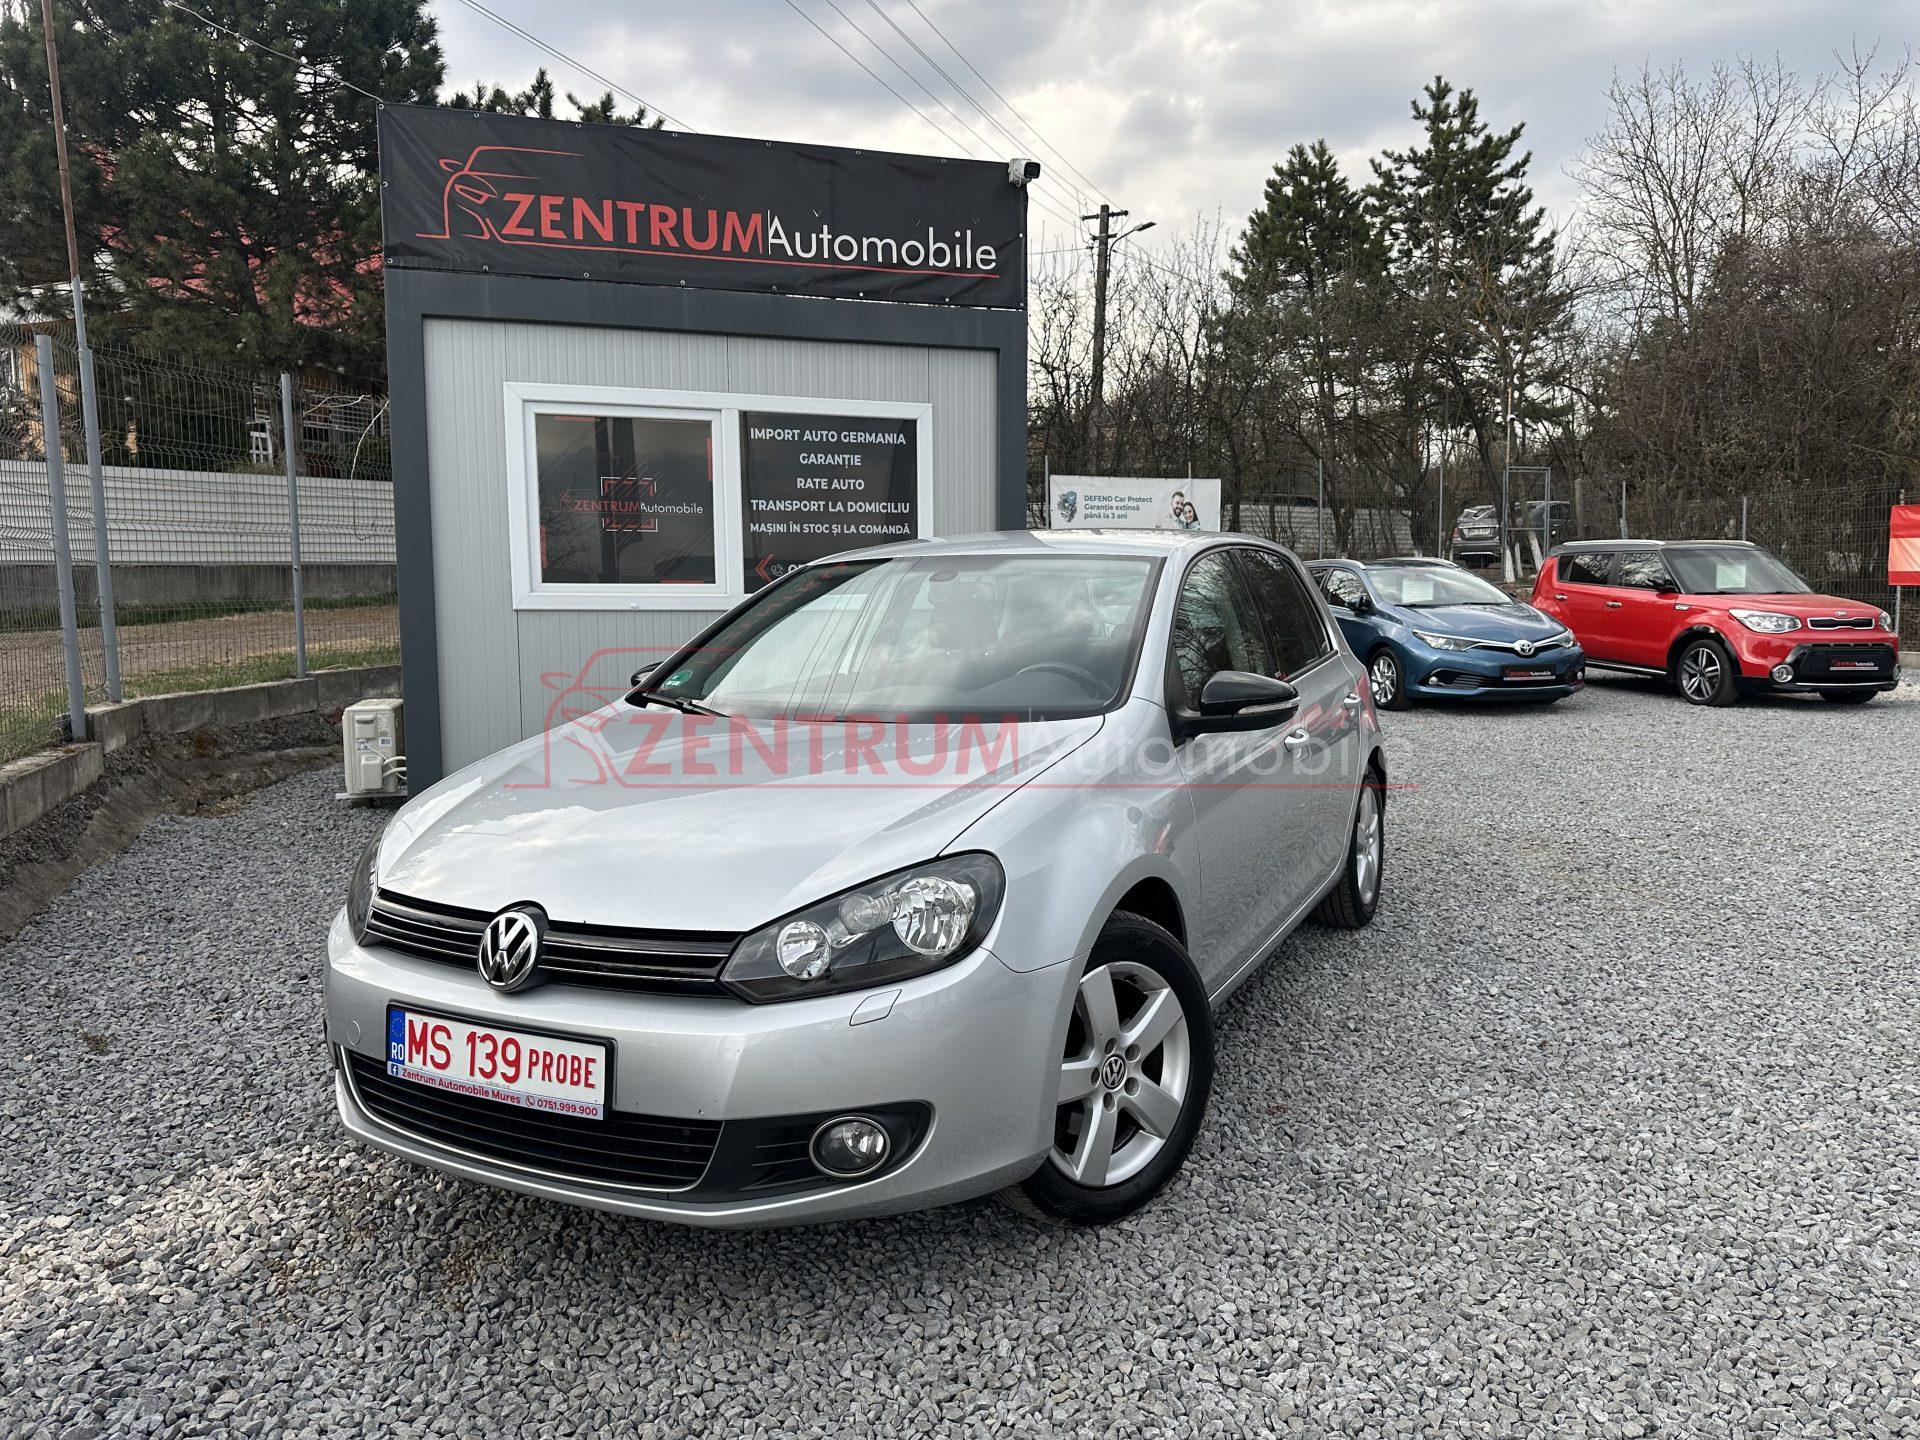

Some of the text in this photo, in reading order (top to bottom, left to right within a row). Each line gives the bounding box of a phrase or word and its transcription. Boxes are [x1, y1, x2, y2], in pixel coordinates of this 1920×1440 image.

[500, 192, 998, 271] ZENTRUM Automobile
[750, 428, 906, 444] IMPORT AUTO GERMANIA
[800, 453, 862, 468] GARANȚIE
[796, 478, 865, 490] RATE AUTO
[574, 500, 704, 514] ZENTRUM Automobile
[750, 499, 910, 513] TRANSPORT LA DOMICILIU
[750, 521, 911, 536] MAȘINI ÎN STOC ȘI LA COMANDĂ
[391, 1019, 596, 1089] RO MS 139 PROBE
[402, 1069, 437, 1086] Zentrum
[438, 1079, 489, 1098] Automobile
[492, 1090, 521, 1104] Mures
[537, 1099, 598, 1116] 0751.999.900
